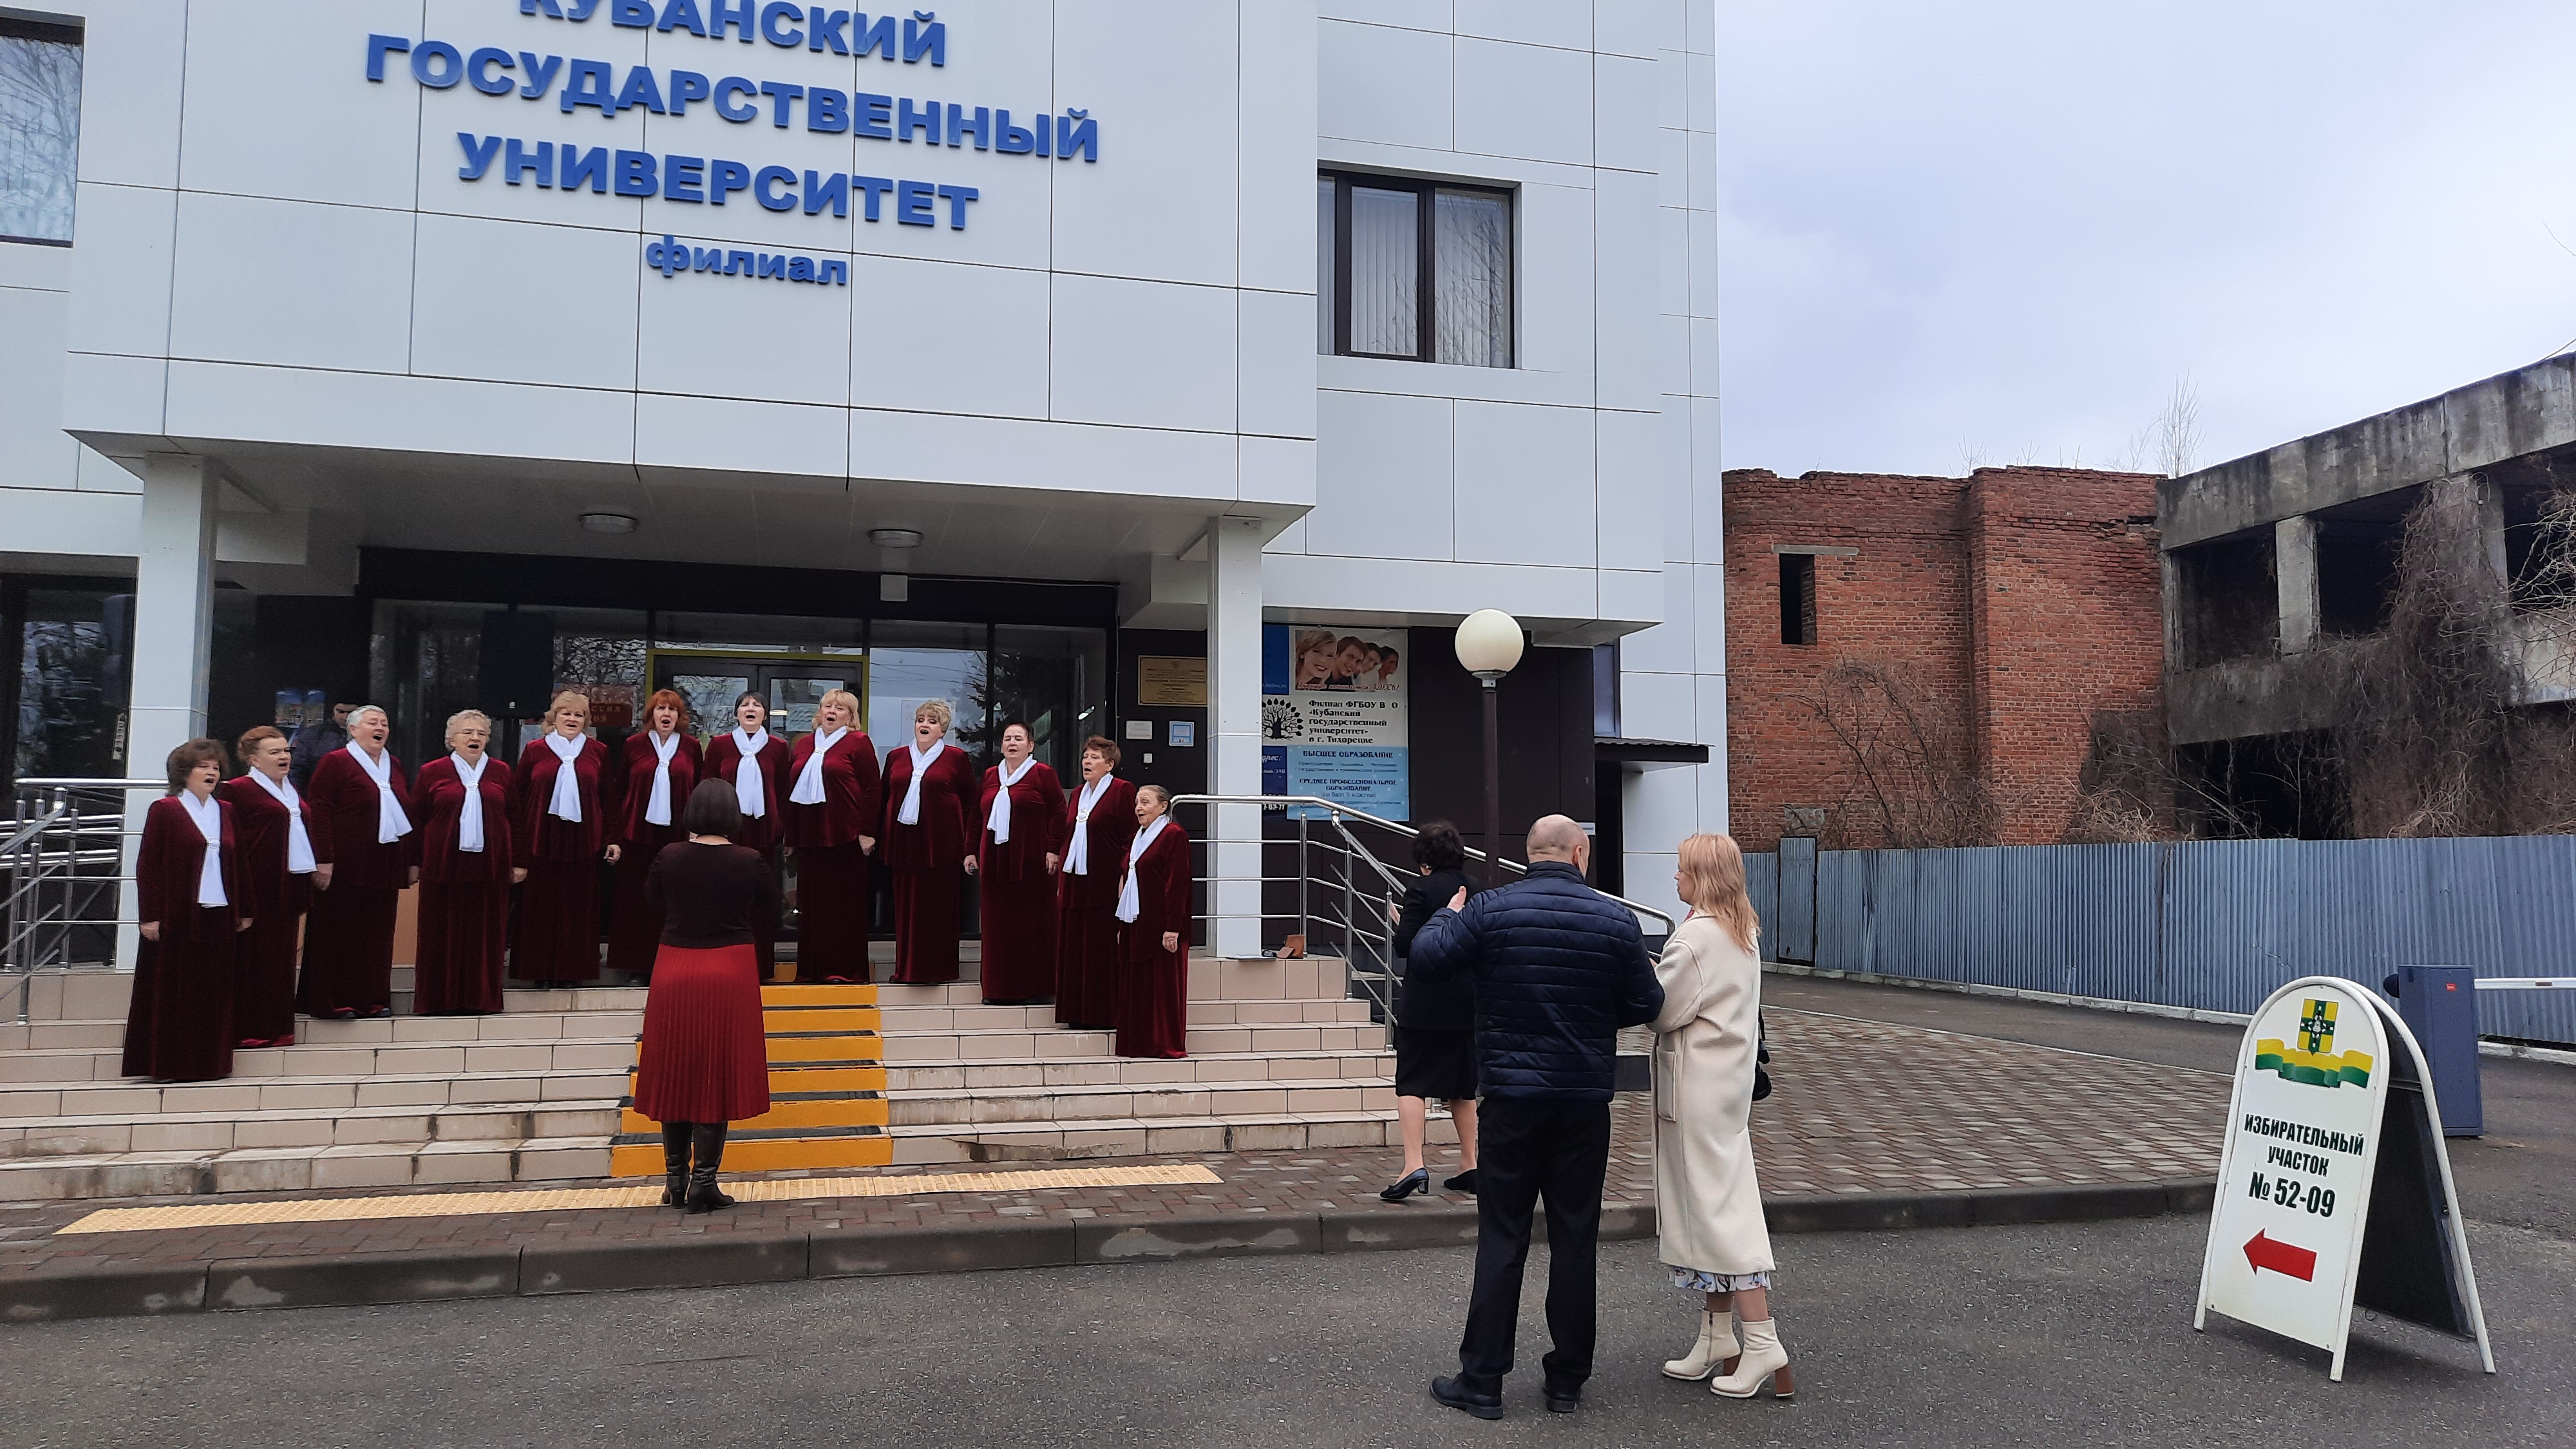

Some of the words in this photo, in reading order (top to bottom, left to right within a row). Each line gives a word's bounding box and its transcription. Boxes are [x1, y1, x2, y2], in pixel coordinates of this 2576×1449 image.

[365, 33, 1099, 162] ГОСУДАРСТВЕННЫЙ
[457, 131, 980, 230] УНИВЕРСИТЕТ
[645, 234, 849, 284] филиал
[1309, 719, 1387, 727] государственный
[1327, 735, 1373, 744] Тихорецке
[2244, 1113, 2365, 1156] ИЗБИРАТЕЛЬНЫЙ
[2267, 1145, 2329, 1177] УЧАСТОК
[2248, 1171, 2271, 1200] №
[2274, 1177, 2336, 1217] 52-09
